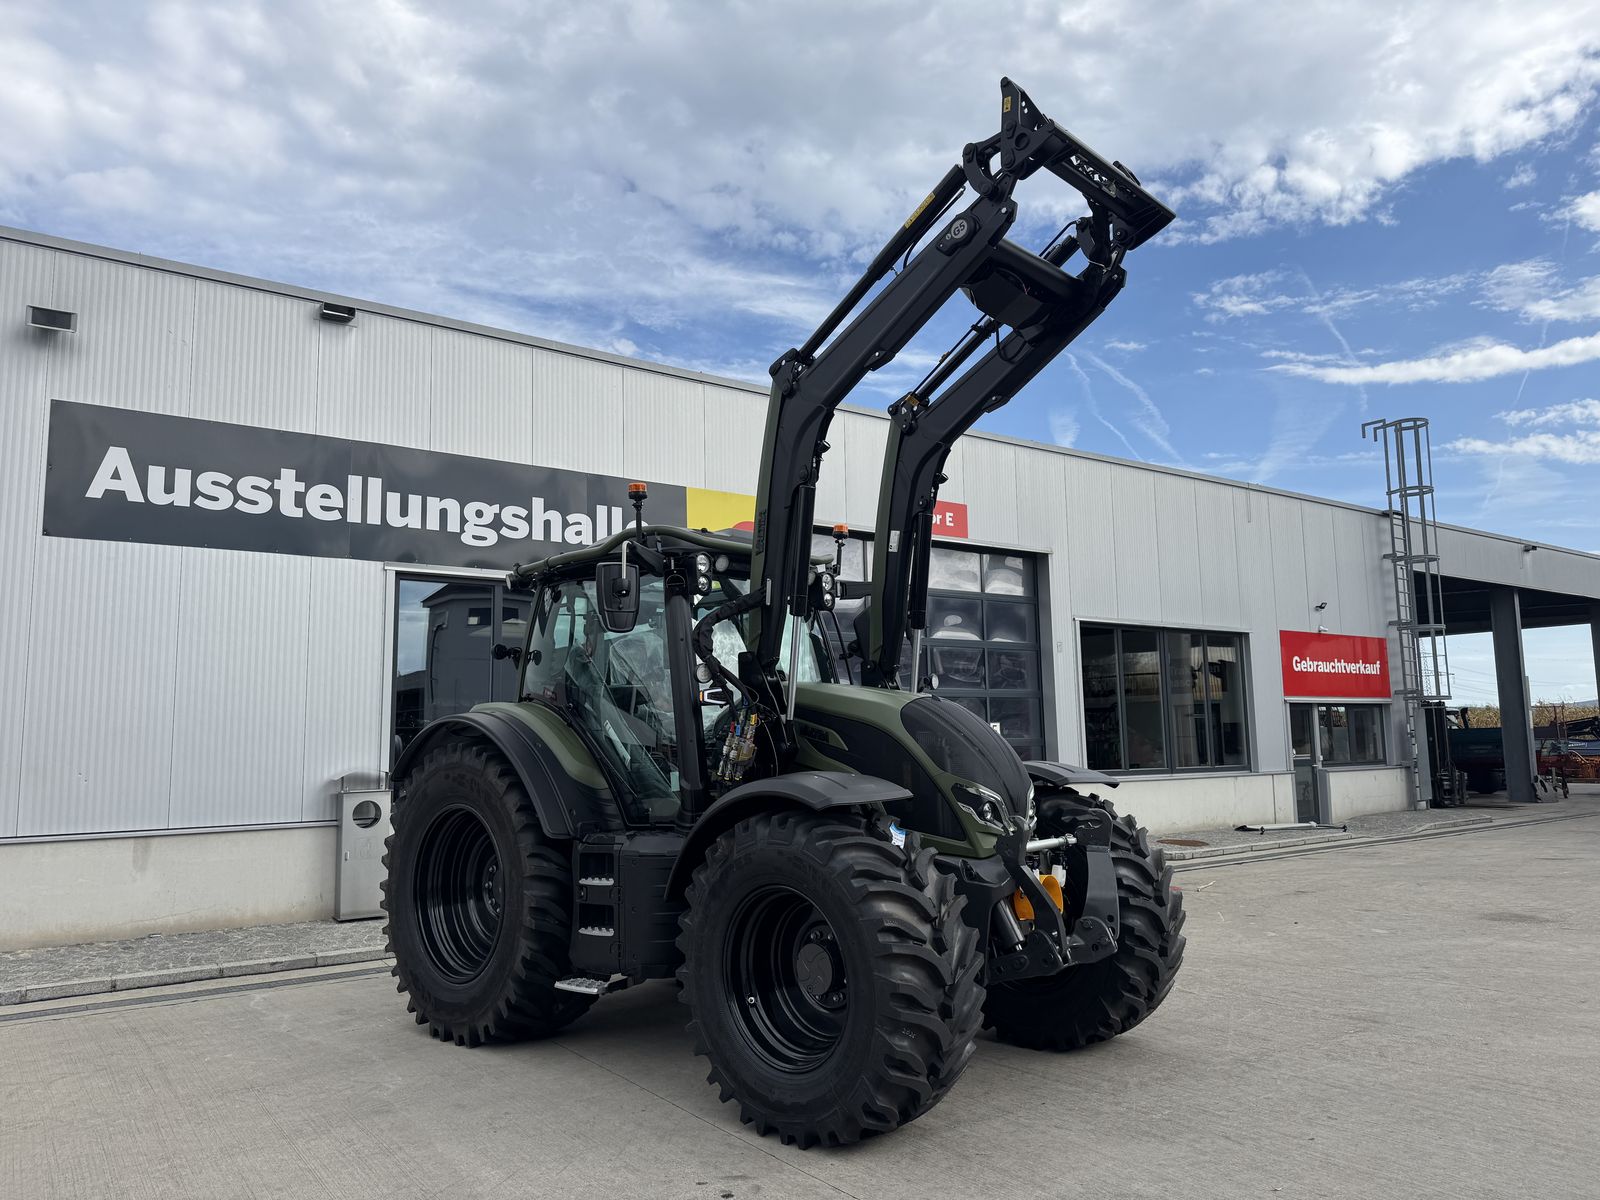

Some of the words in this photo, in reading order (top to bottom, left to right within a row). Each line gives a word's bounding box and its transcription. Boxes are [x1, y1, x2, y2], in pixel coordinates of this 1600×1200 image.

[953, 221, 965, 236] G5
[86, 446, 648, 546] Ausstellungshall
[945, 512, 954, 526] E
[1292, 655, 1380, 675] Gebrauchtverkauf
